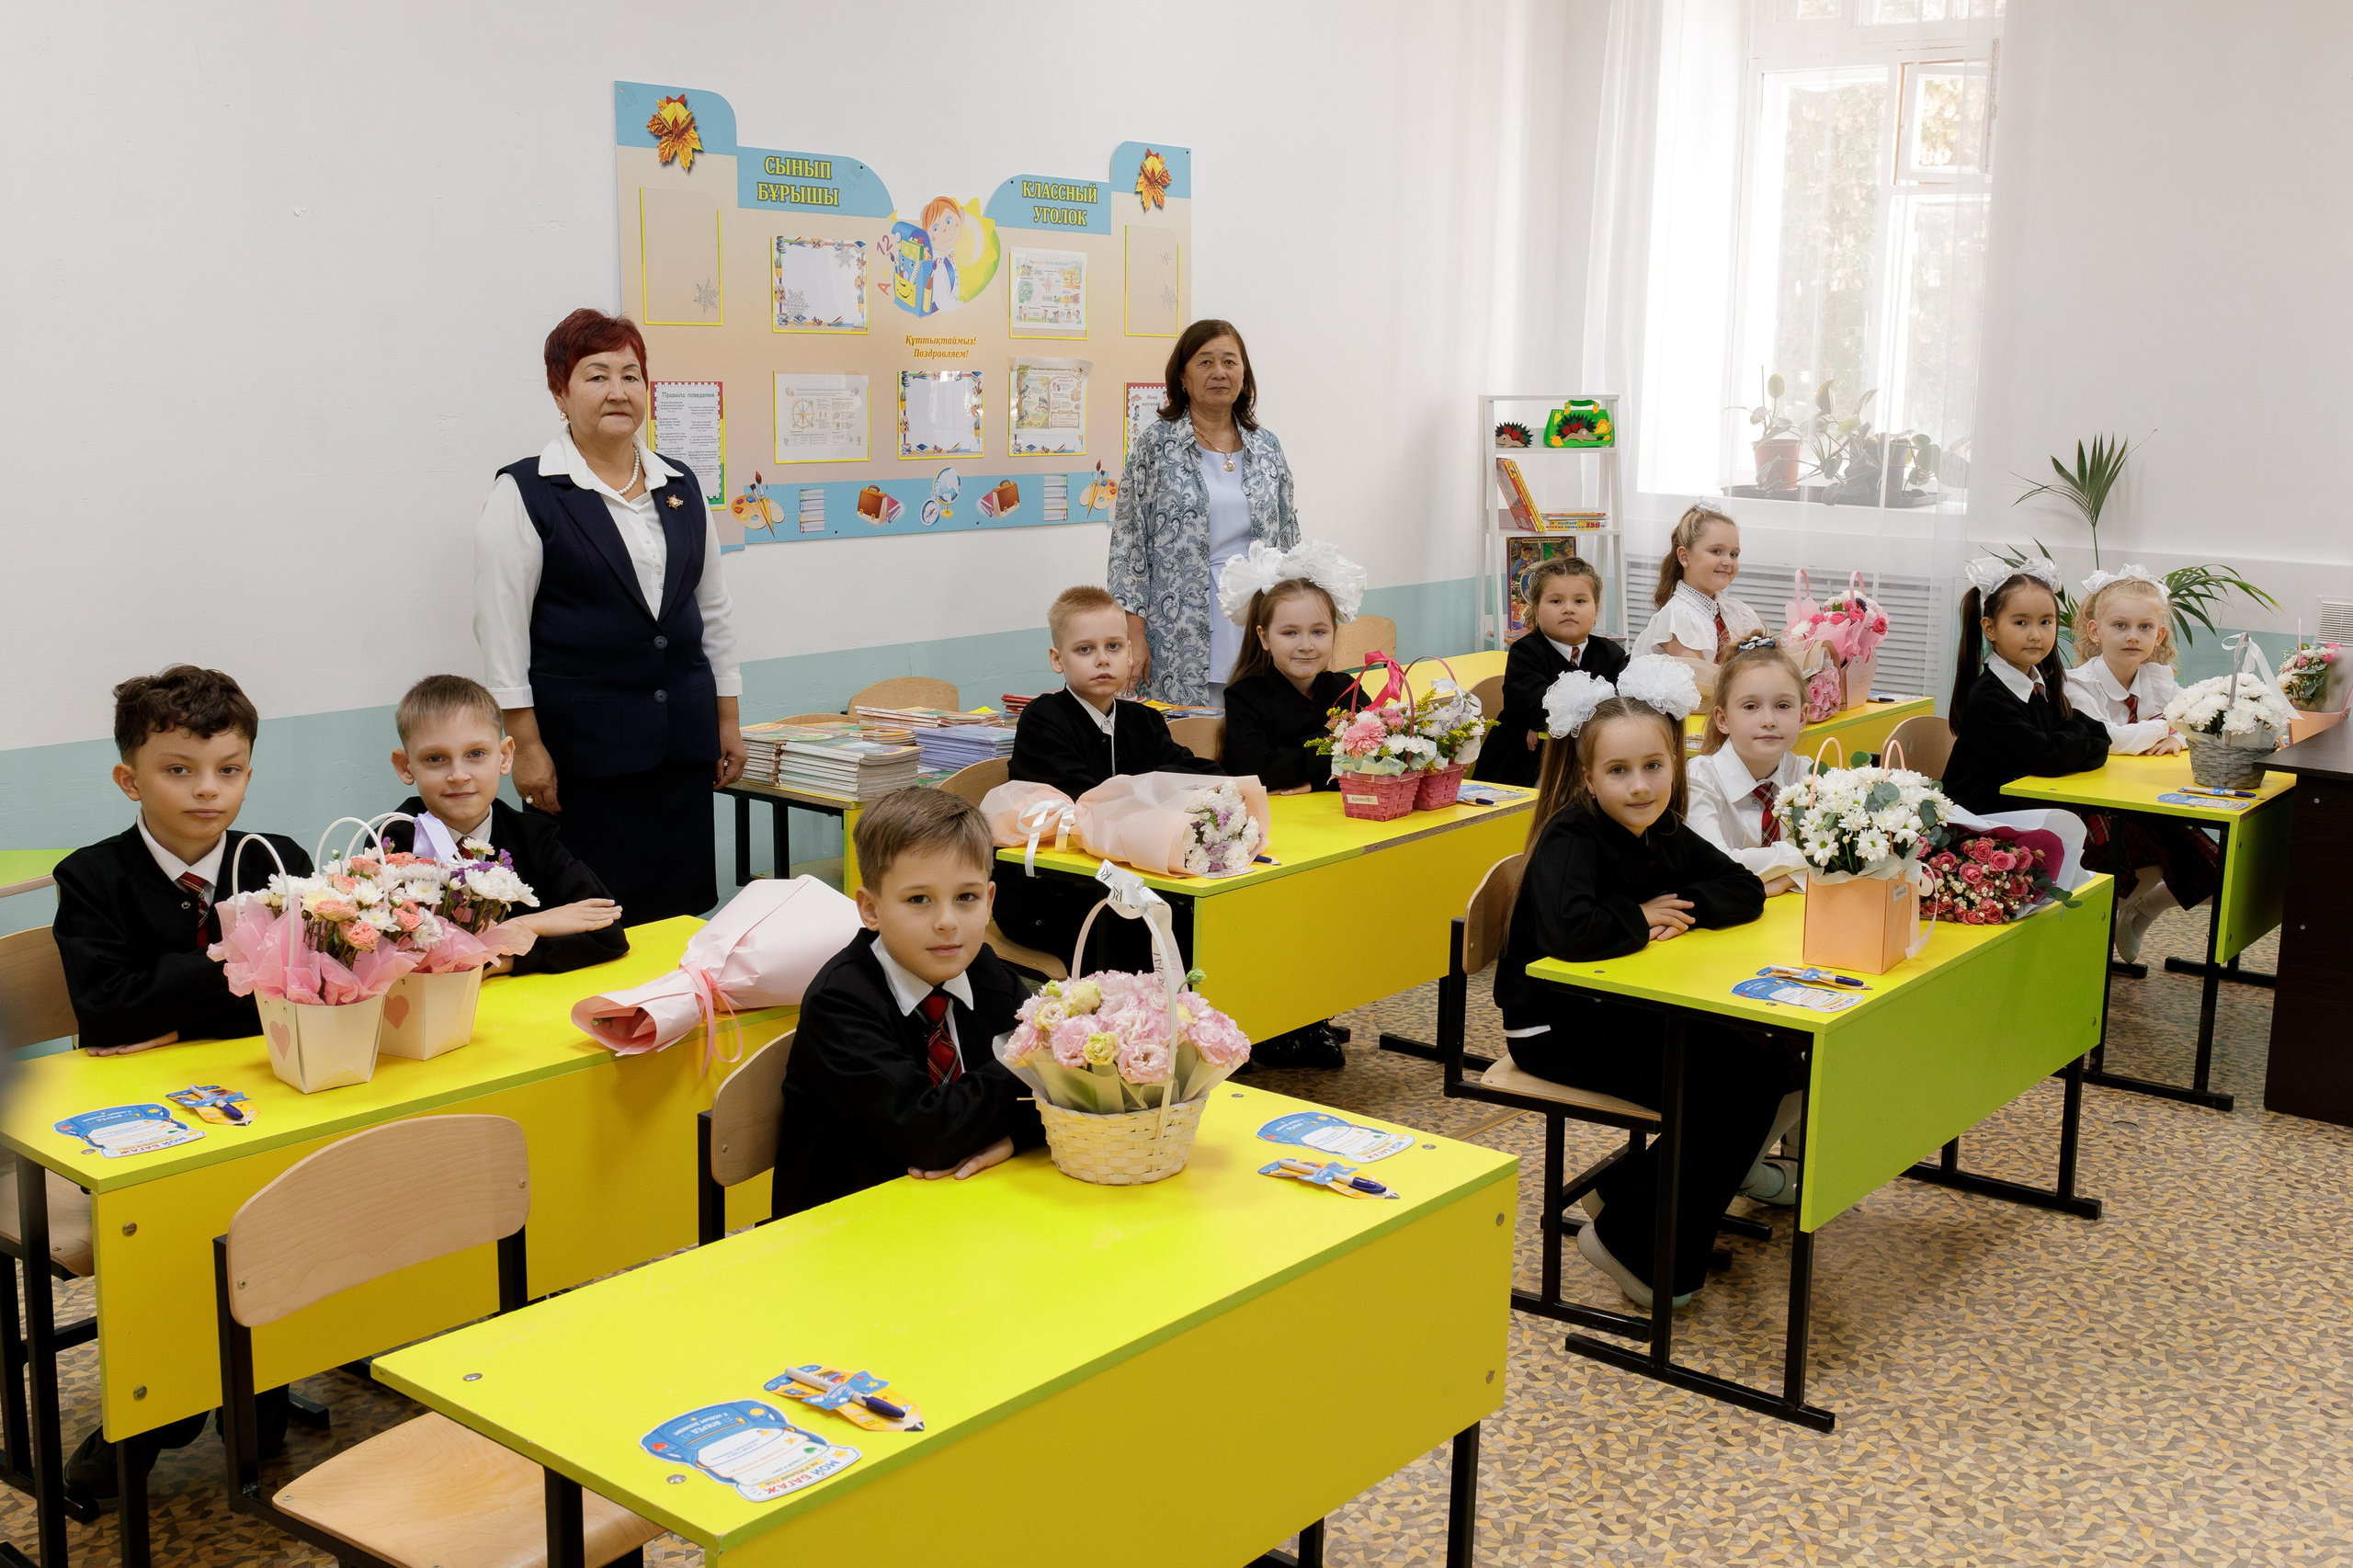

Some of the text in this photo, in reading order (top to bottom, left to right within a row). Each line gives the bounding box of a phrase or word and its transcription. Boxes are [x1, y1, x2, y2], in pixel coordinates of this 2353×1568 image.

[764, 155, 832, 180] СЫНЫП
[756, 182, 840, 207] БҰРЫШЫ
[1021, 180, 1098, 204] КЛАССНЫЙ
[1033, 205, 1087, 226] УГОЛОК
[913, 348, 969, 359] Поздравляем!
[763, 1460, 840, 1494] МОЙ БАГАЖ
